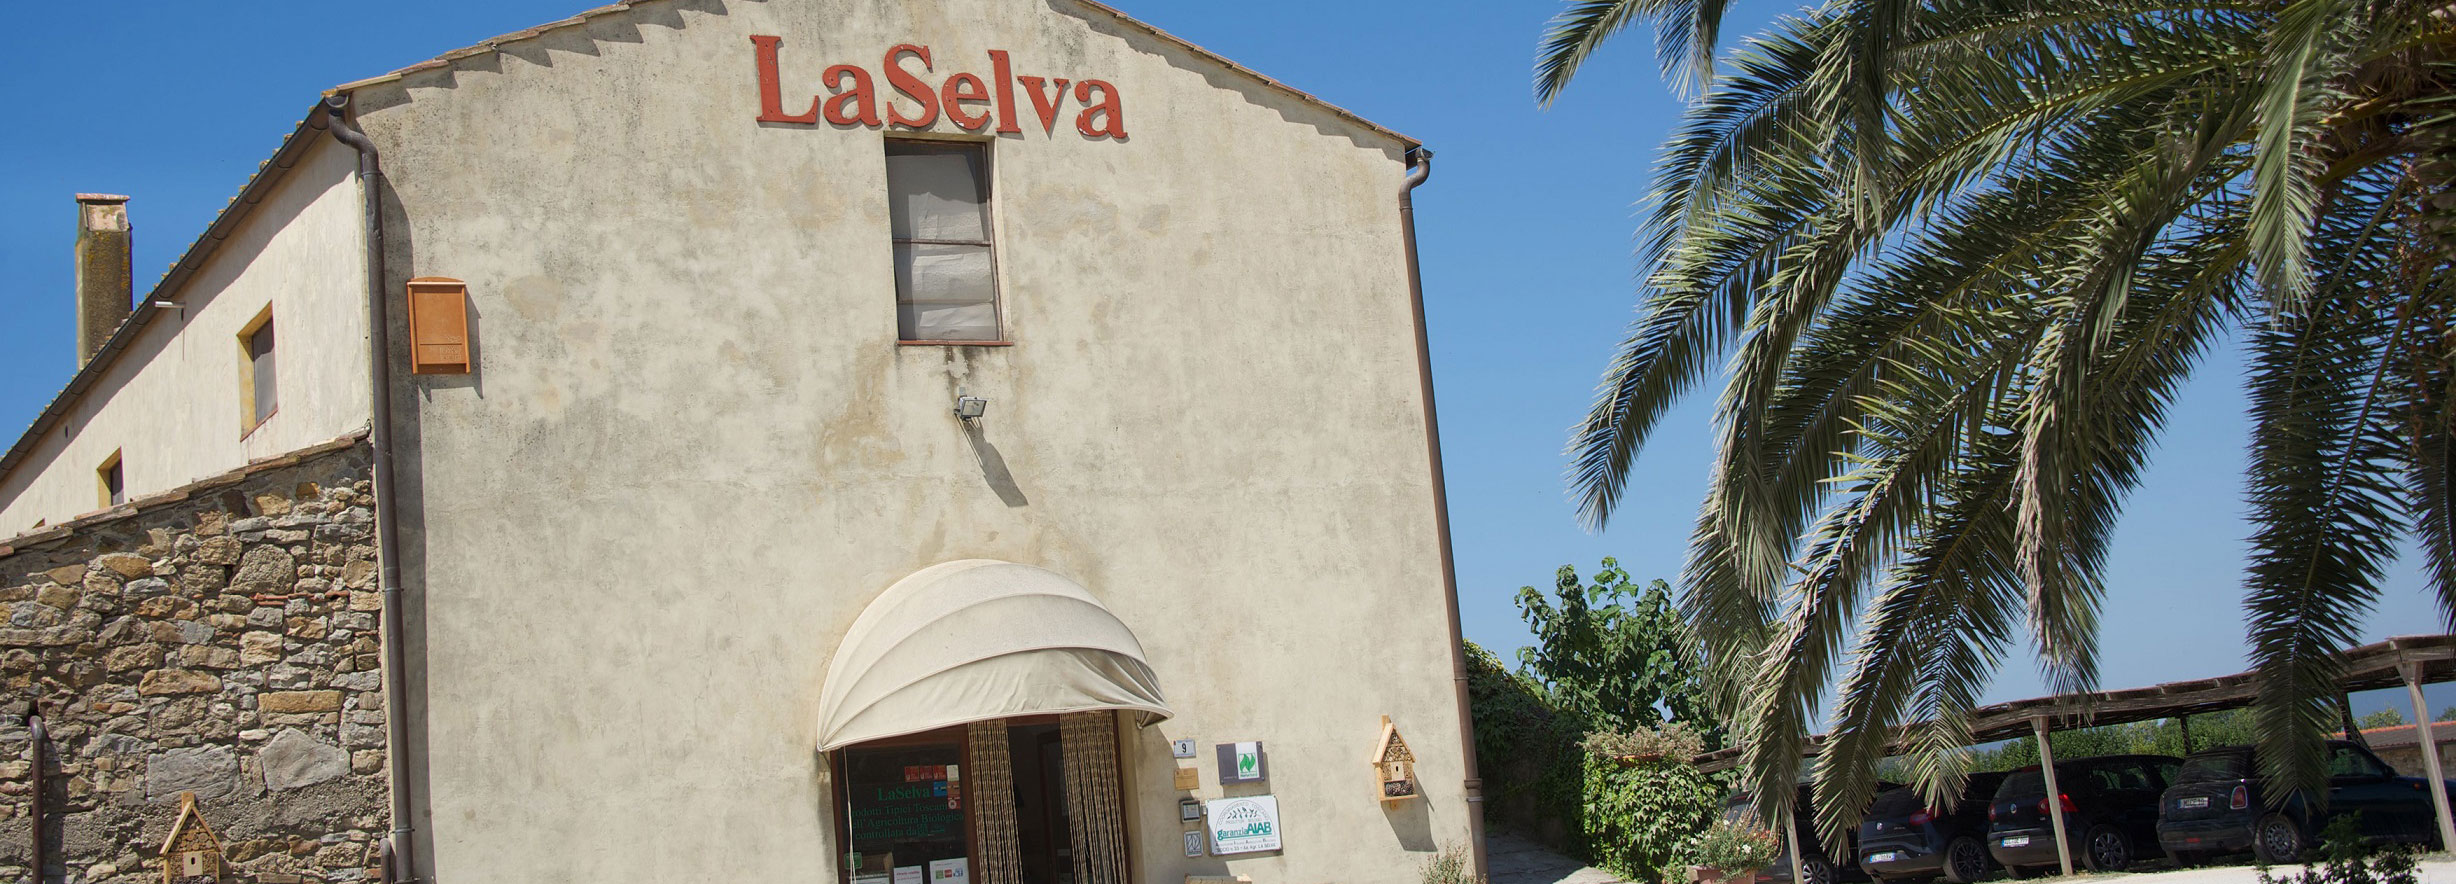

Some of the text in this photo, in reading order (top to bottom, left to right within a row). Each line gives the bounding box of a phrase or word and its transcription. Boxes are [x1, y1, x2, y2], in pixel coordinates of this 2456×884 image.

[749, 34, 1129, 140] LaSelva
[1181, 743, 1187, 753] 9
[878, 787, 930, 801] LaSelva
